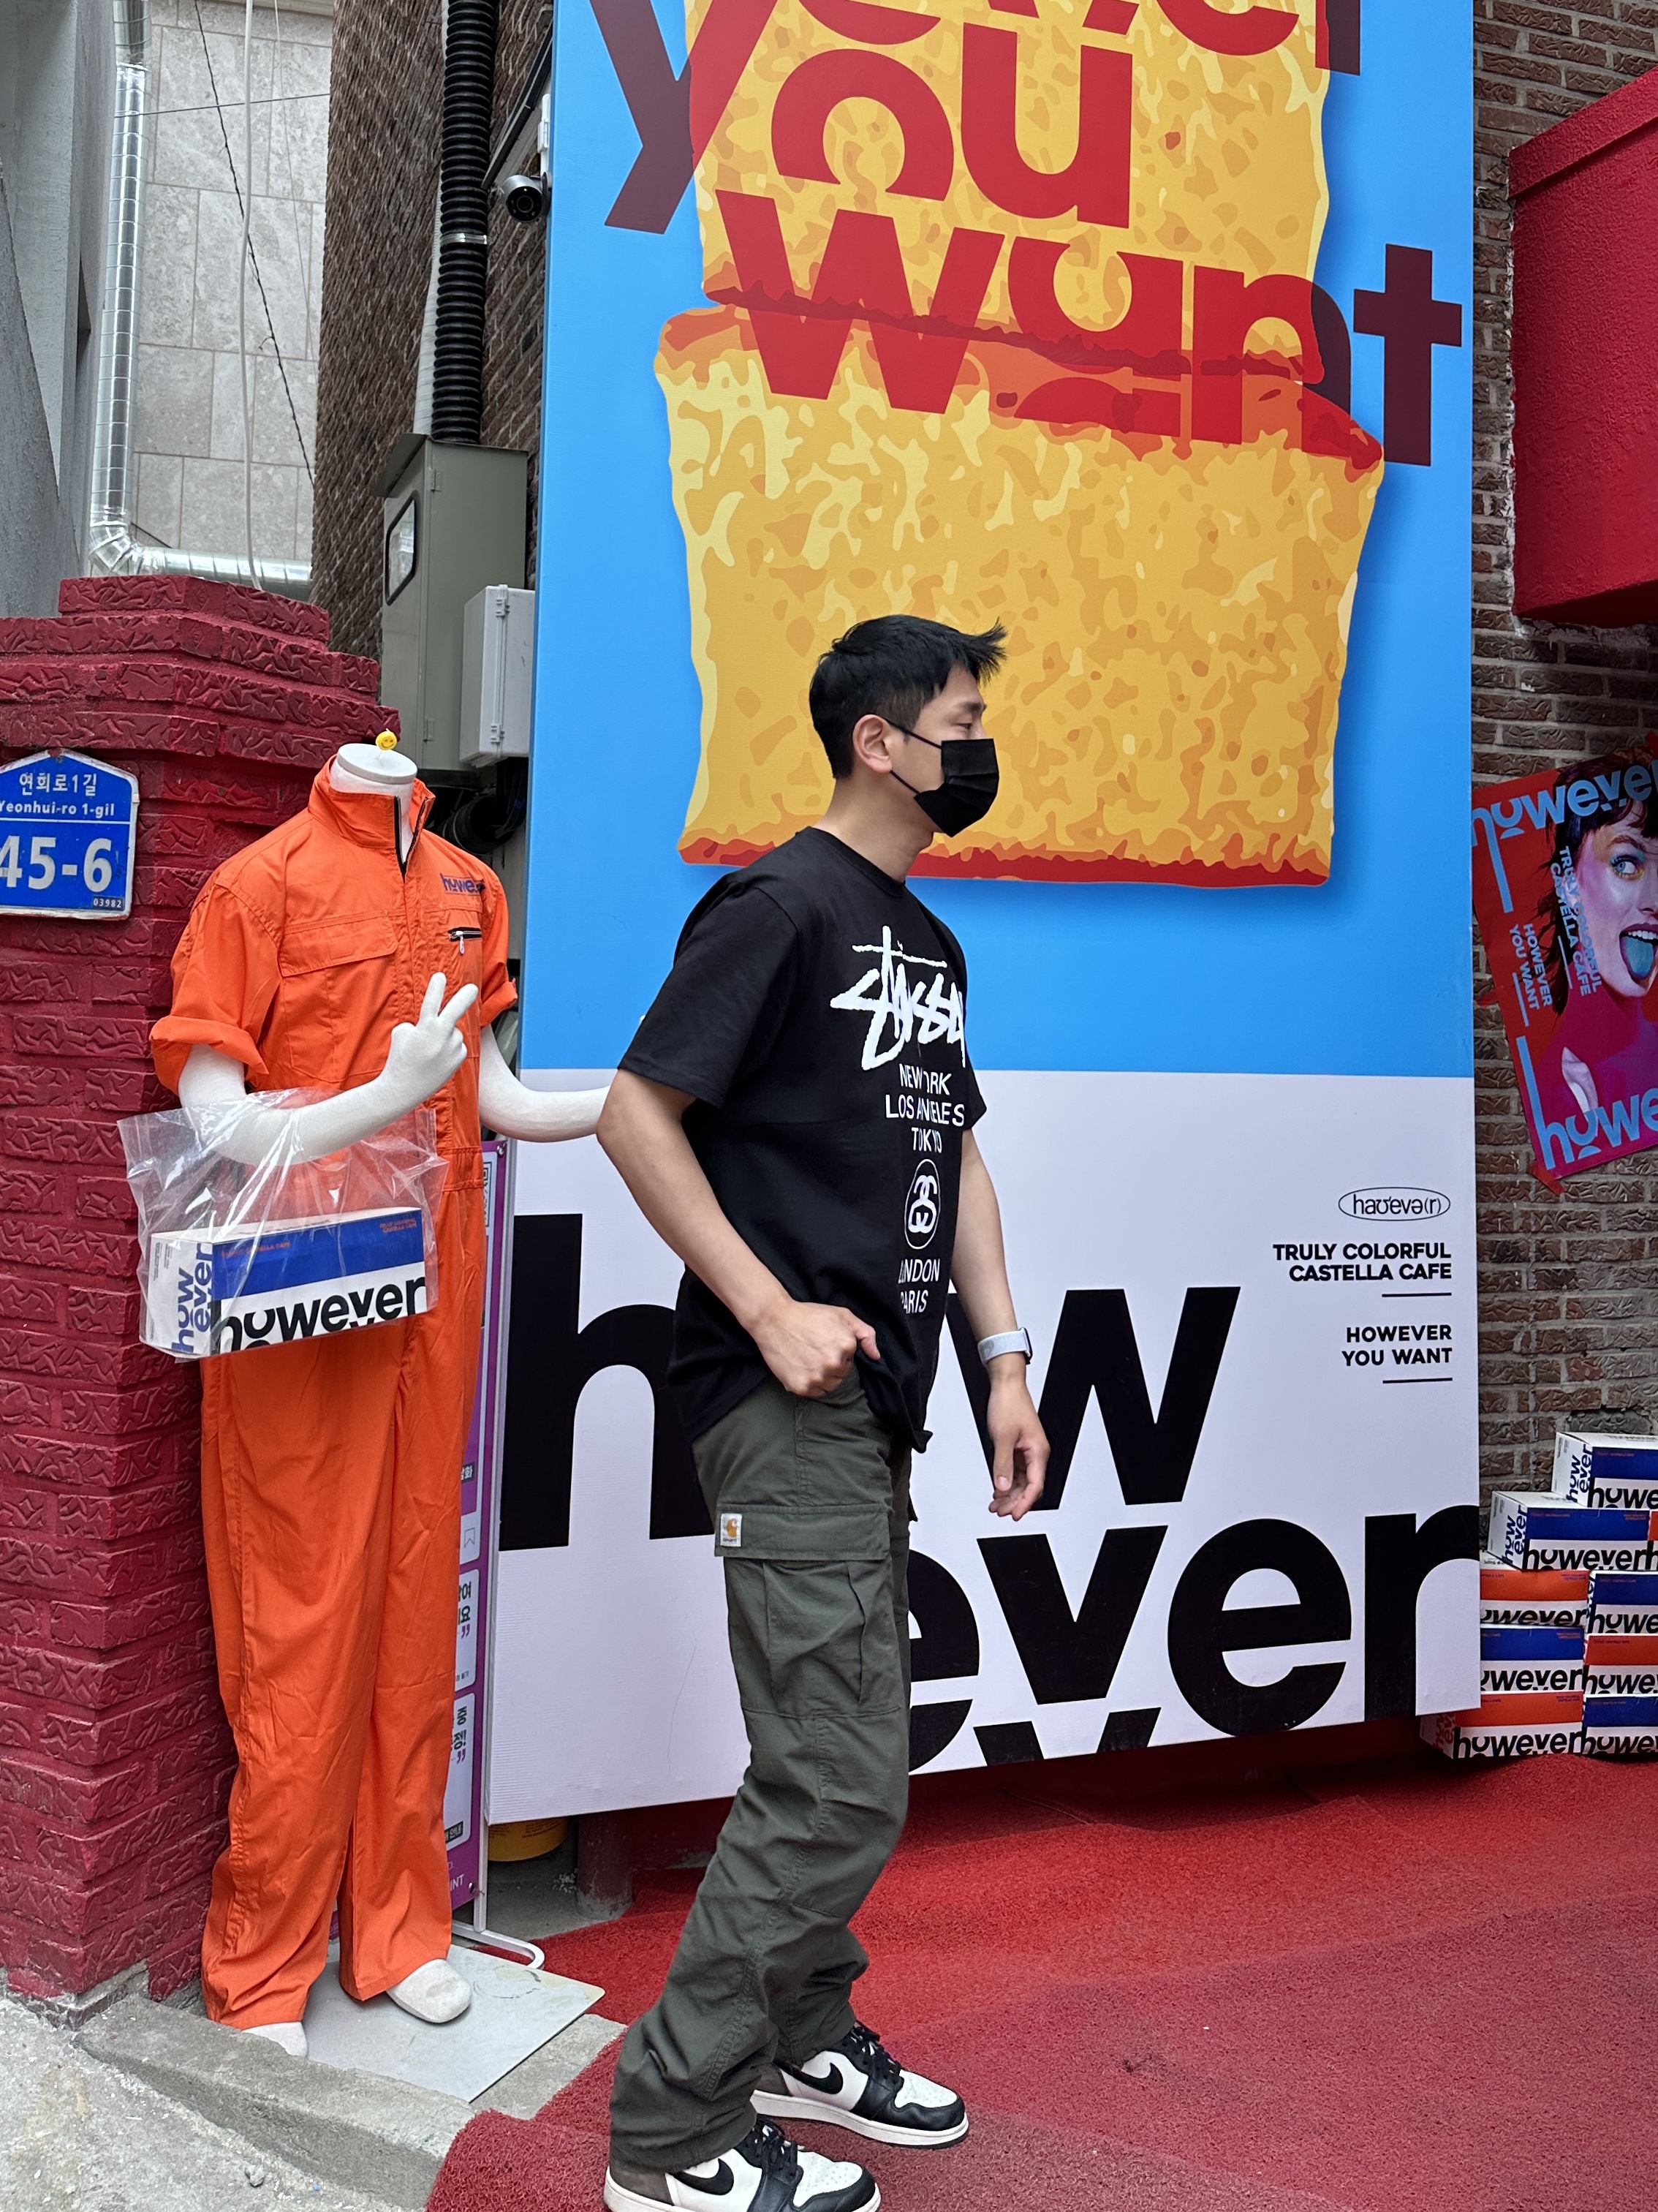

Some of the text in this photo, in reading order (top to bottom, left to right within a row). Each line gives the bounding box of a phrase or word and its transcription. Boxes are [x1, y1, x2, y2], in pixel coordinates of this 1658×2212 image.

[19, 772, 97, 797] 연희로1길
[82, 803, 115, 818] 1-gil
[0, 835, 113, 893] 45-6
[93, 898, 122, 909] 03982
[1551, 862, 1591, 997] CASTELLA CAFE
[1559, 845, 1602, 993] TRULY COLORFUL
[1510, 924, 1540, 1010] YOU WANT
[1523, 923, 1553, 1007] HOWEVER
[898, 1063, 923, 1090] NEW
[885, 1094, 915, 1120] LOS
[1273, 1242, 1451, 1260] TRULY COLORFUL
[1289, 1263, 1452, 1281] CASTELLA CAFE
[171, 1267, 194, 1353] how
[1347, 1324, 1452, 1343] HOWEVER
[1341, 1348, 1453, 1366] YOU WANT
[499, 1214, 1241, 1549] hw
[1523, 1537, 1646, 1571] however
